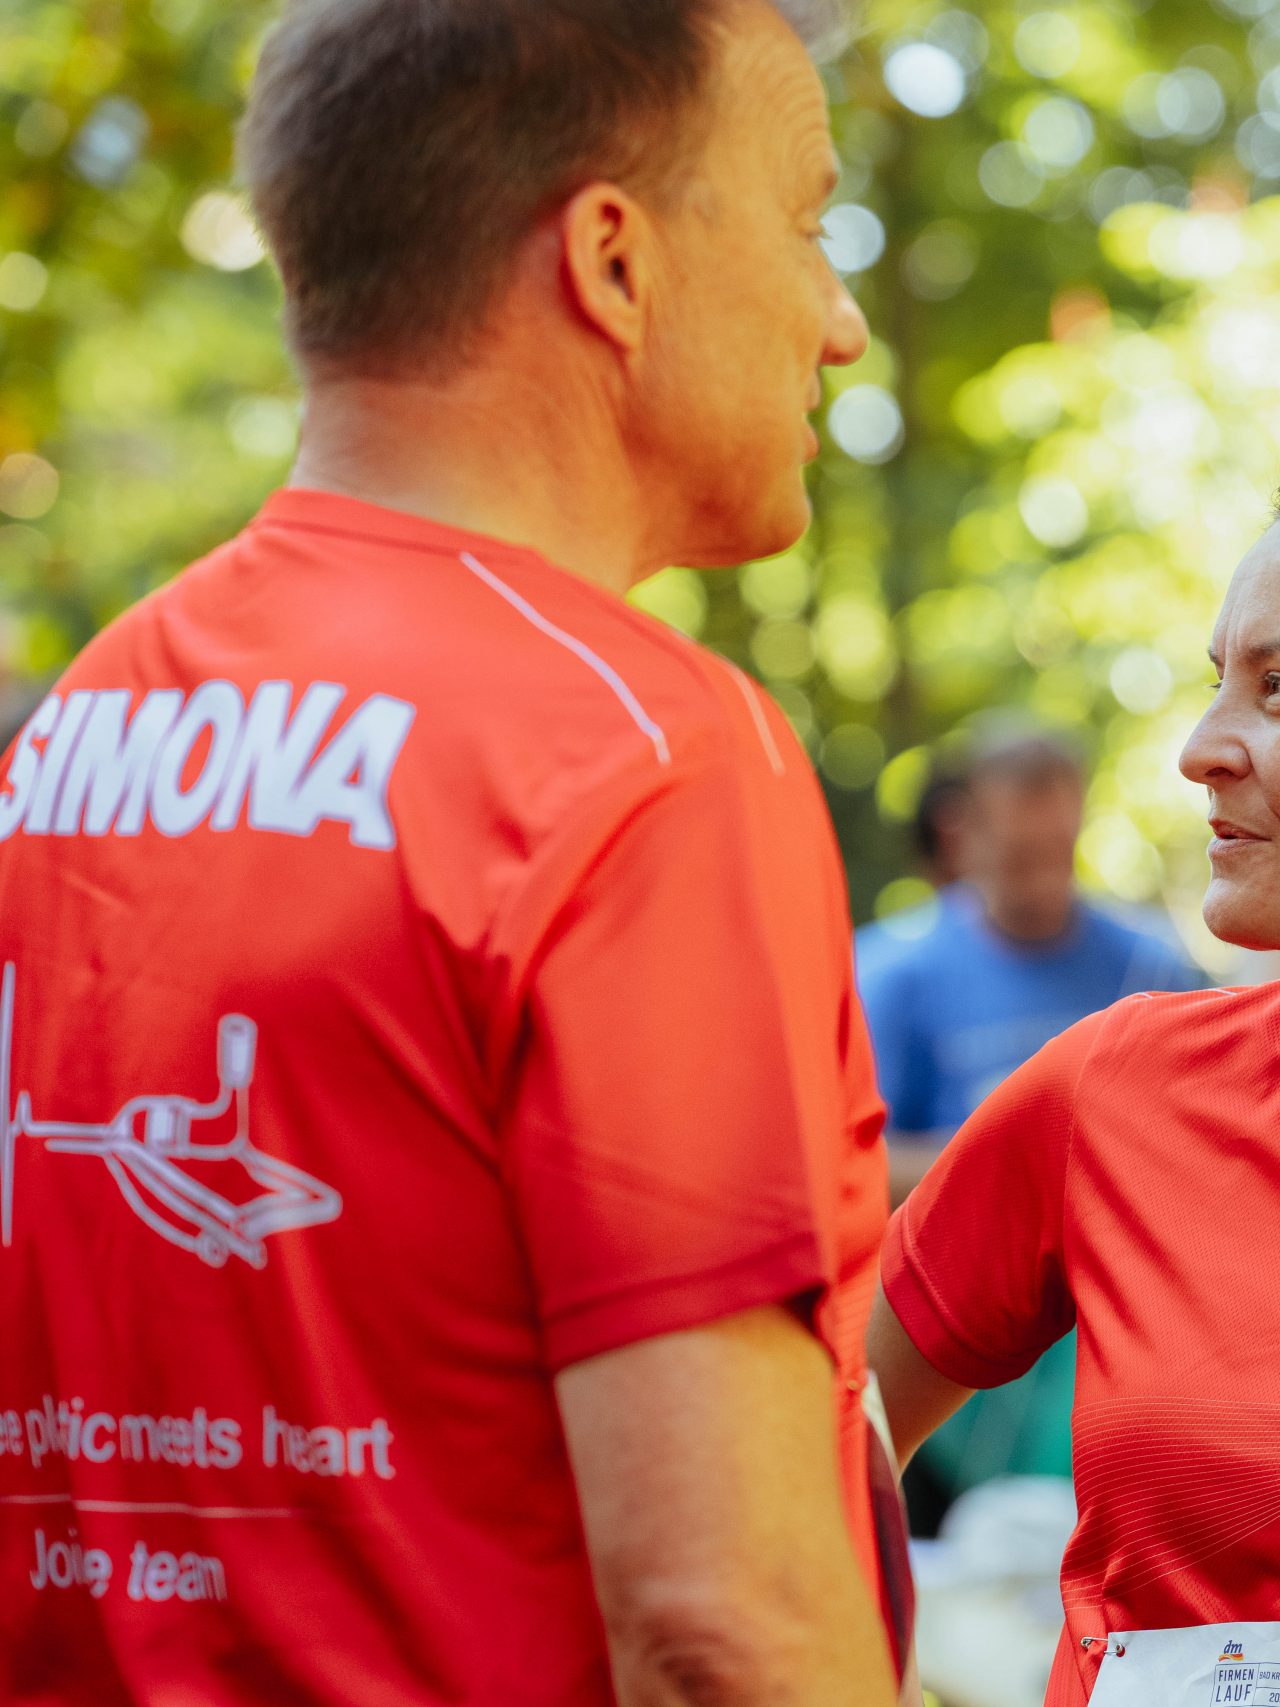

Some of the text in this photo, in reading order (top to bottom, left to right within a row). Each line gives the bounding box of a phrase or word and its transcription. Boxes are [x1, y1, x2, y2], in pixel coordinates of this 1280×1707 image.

[0, 678, 417, 852] SIMONA
[1223, 1640, 1242, 1654] dm
[1219, 1669, 1254, 1682] FIRMEN
[1259, 1671, 1270, 1680] BAD
[1215, 1684, 1252, 1703] LAUF
